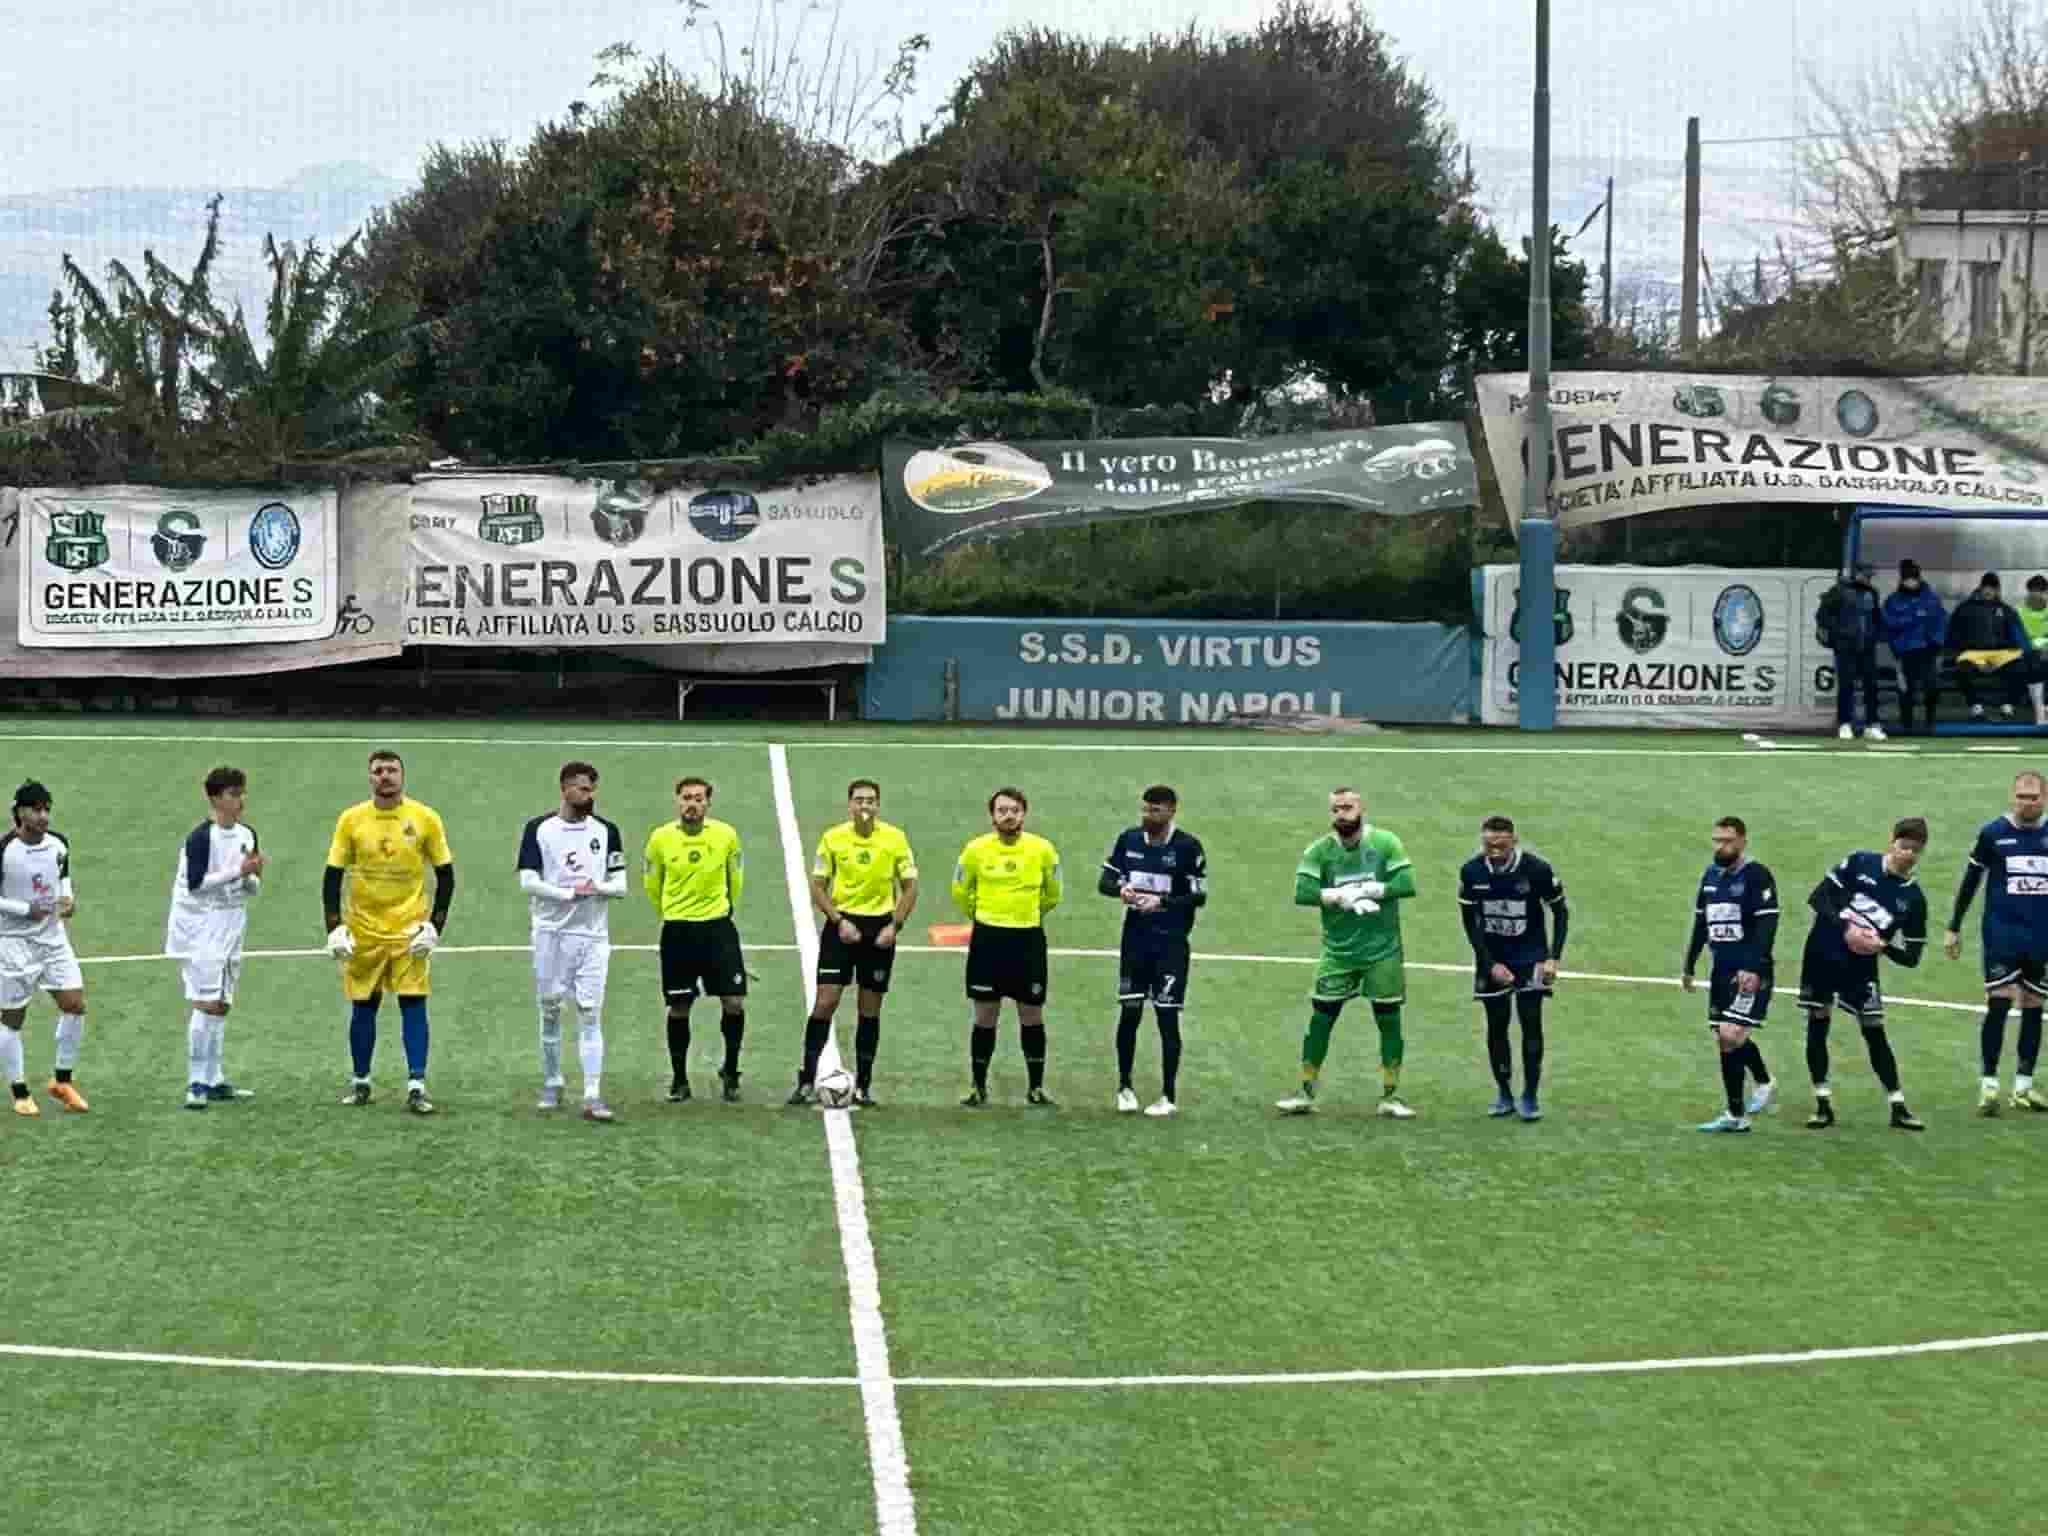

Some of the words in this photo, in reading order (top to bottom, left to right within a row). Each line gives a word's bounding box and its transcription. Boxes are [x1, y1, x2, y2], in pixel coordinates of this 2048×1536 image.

[1060, 450, 1087, 473] Il
[1099, 453, 1178, 474] vero
[767, 503, 865, 521] SASSUOLO
[44, 577, 284, 609] GENERAZIONE
[406, 556, 813, 609] ENERAZIONE
[830, 556, 867, 605] S
[476, 613, 590, 637] AFFILIATA
[652, 611, 776, 635] SASSUOLO
[783, 610, 864, 634] CALCIO
[1019, 631, 1143, 665] S.S.D.
[1157, 634, 1322, 668] VIRTUS
[1507, 661, 1747, 692] GNERAZIONE
[994, 686, 1166, 721] JUNIOR
[1180, 690, 1345, 722] NAPOLI
